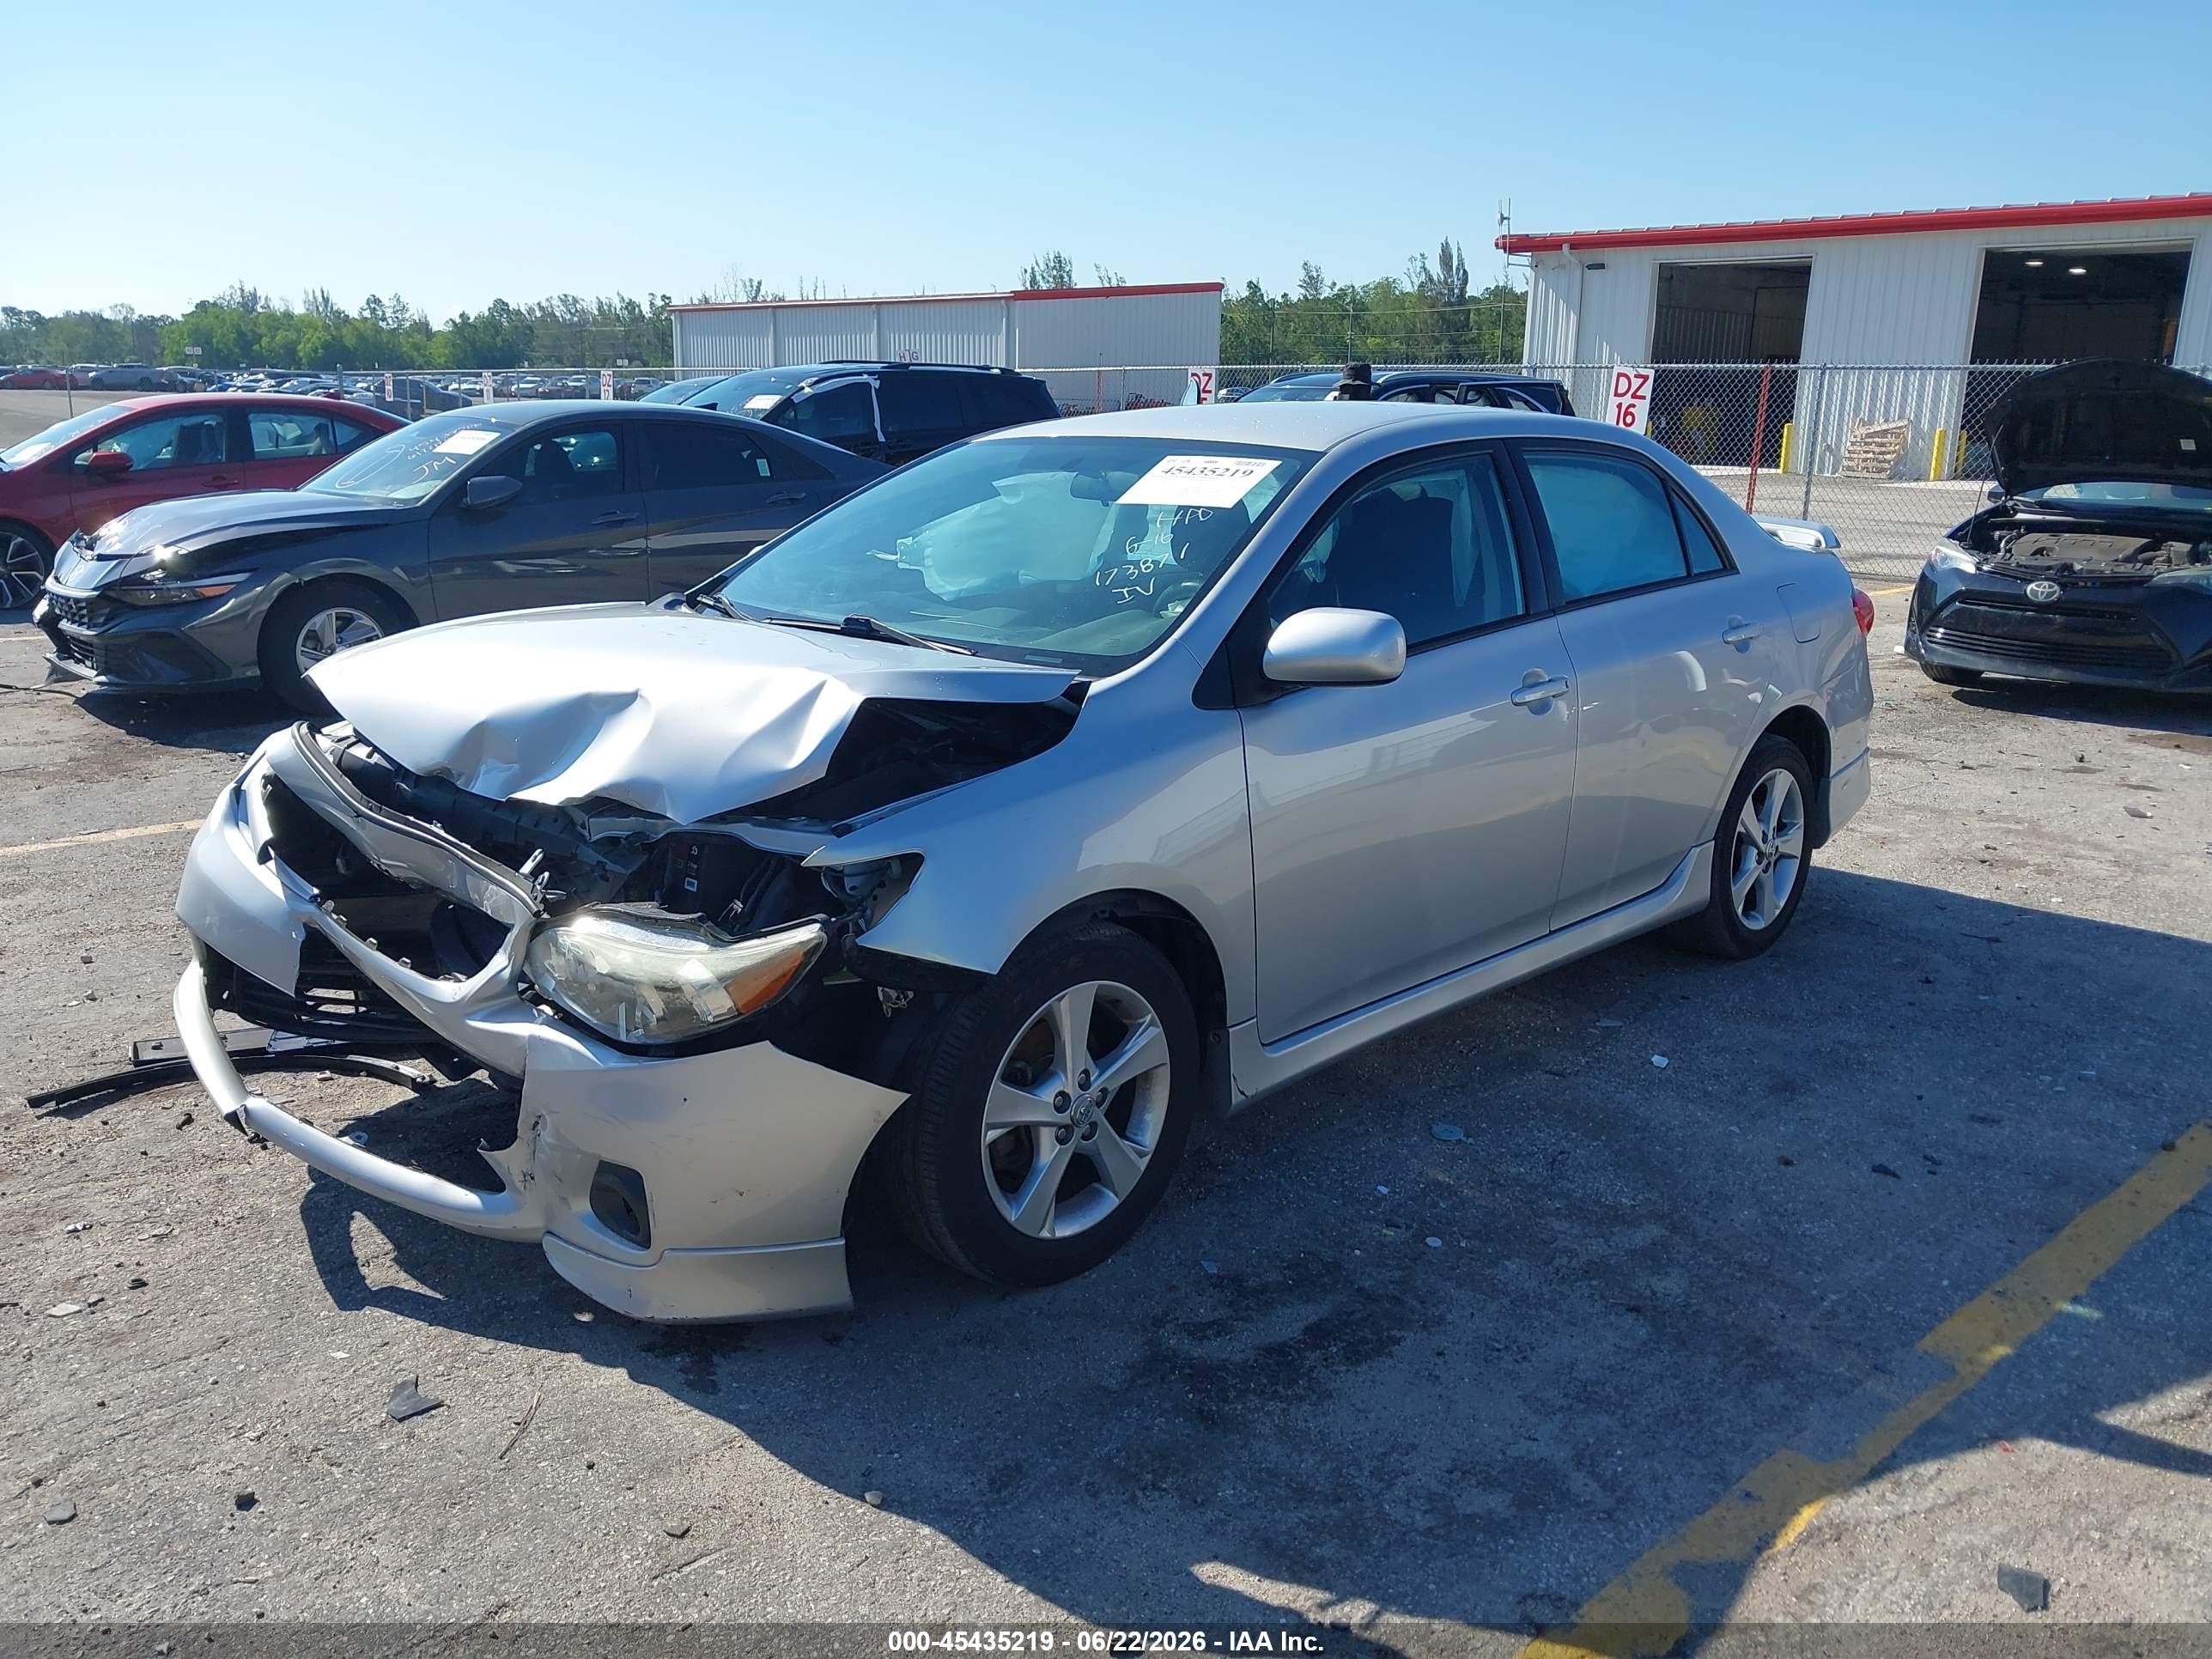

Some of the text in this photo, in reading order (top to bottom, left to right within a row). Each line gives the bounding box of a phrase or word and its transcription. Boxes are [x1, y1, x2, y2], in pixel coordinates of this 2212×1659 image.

[1613, 372, 1650, 400] DZ
[1615, 402, 1637, 428] 16
[1160, 465, 1255, 478] 45435219
